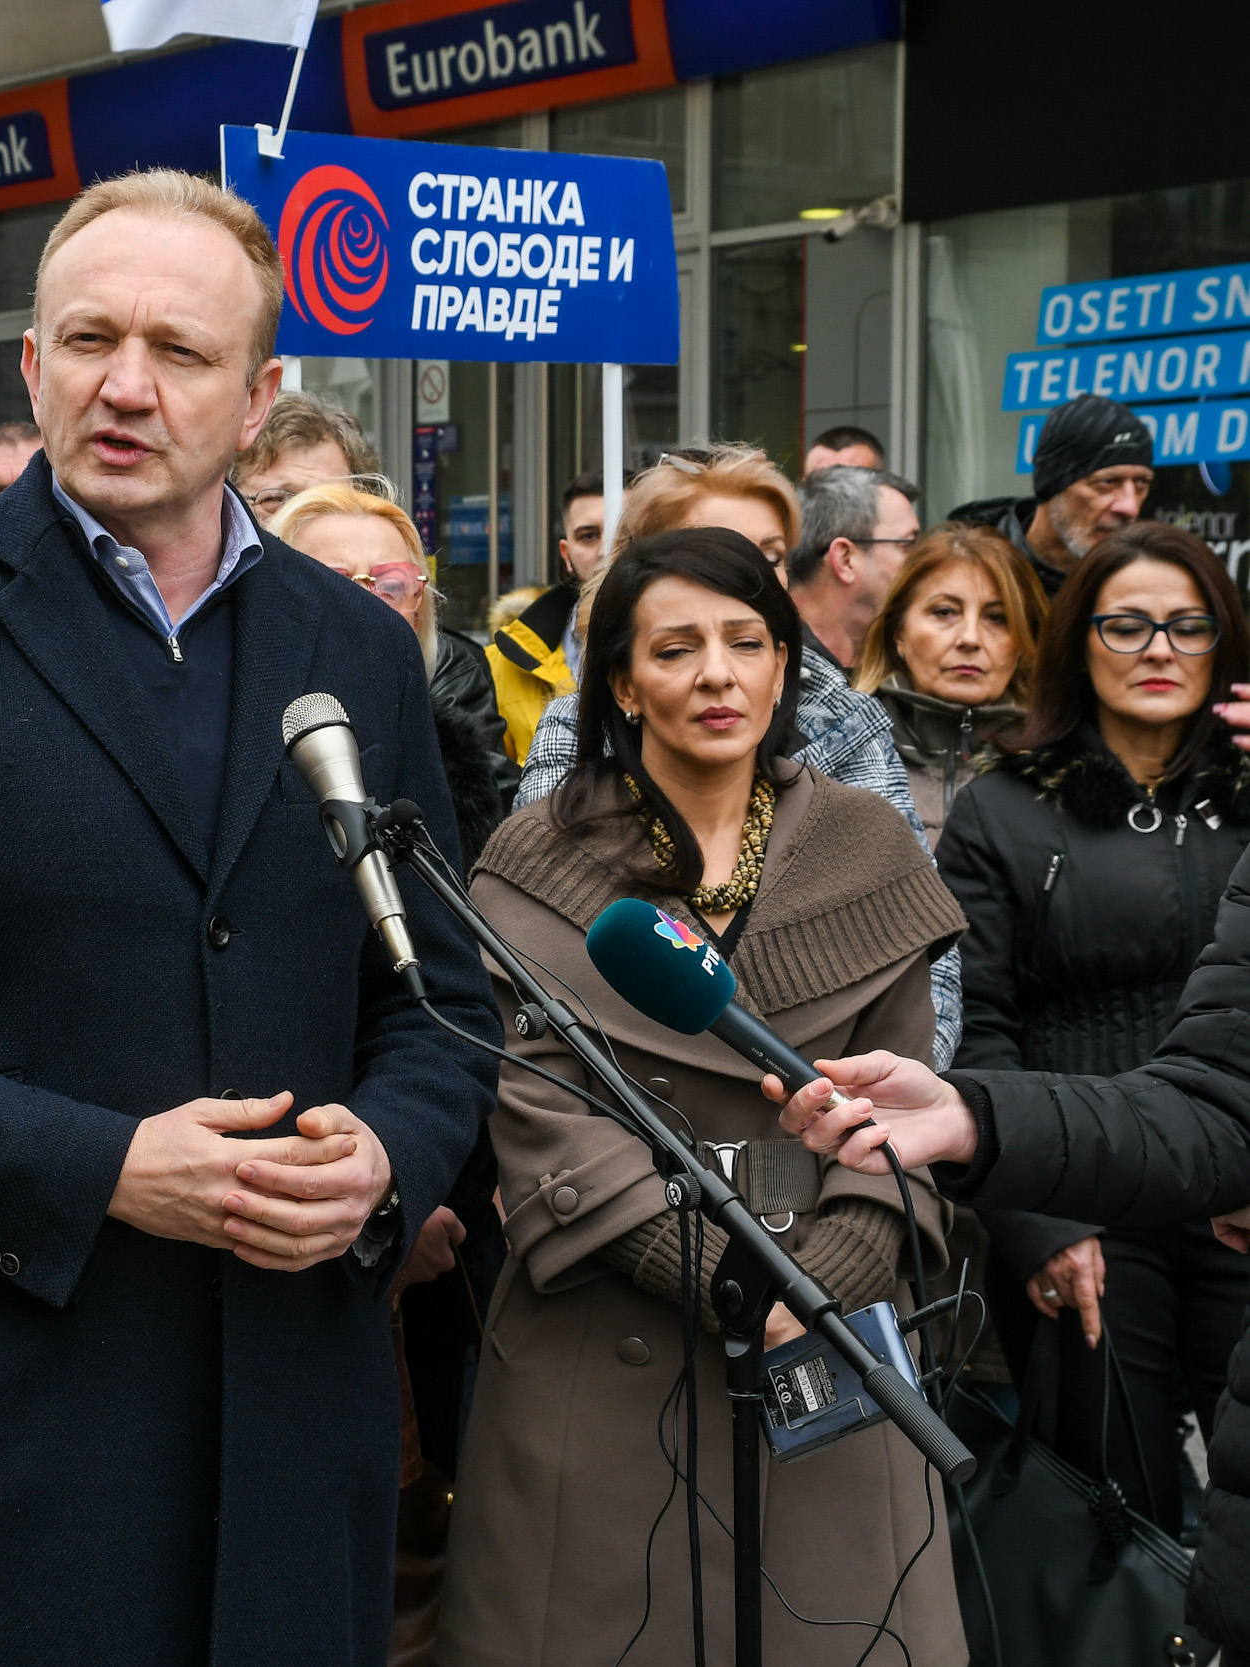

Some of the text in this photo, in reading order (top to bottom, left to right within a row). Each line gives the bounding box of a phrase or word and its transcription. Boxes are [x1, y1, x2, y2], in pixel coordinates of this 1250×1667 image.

[386, 1, 606, 97] Eurobank
[408, 171, 586, 227] СТРАНКА
[411, 227, 635, 288] СЛОБОДЕ И
[411, 284, 562, 342] ПРАВДЕ
[1043, 281, 1177, 338] OSETI
[1014, 344, 1222, 404] TELENOR
[800, 1375, 816, 1406] 507819
